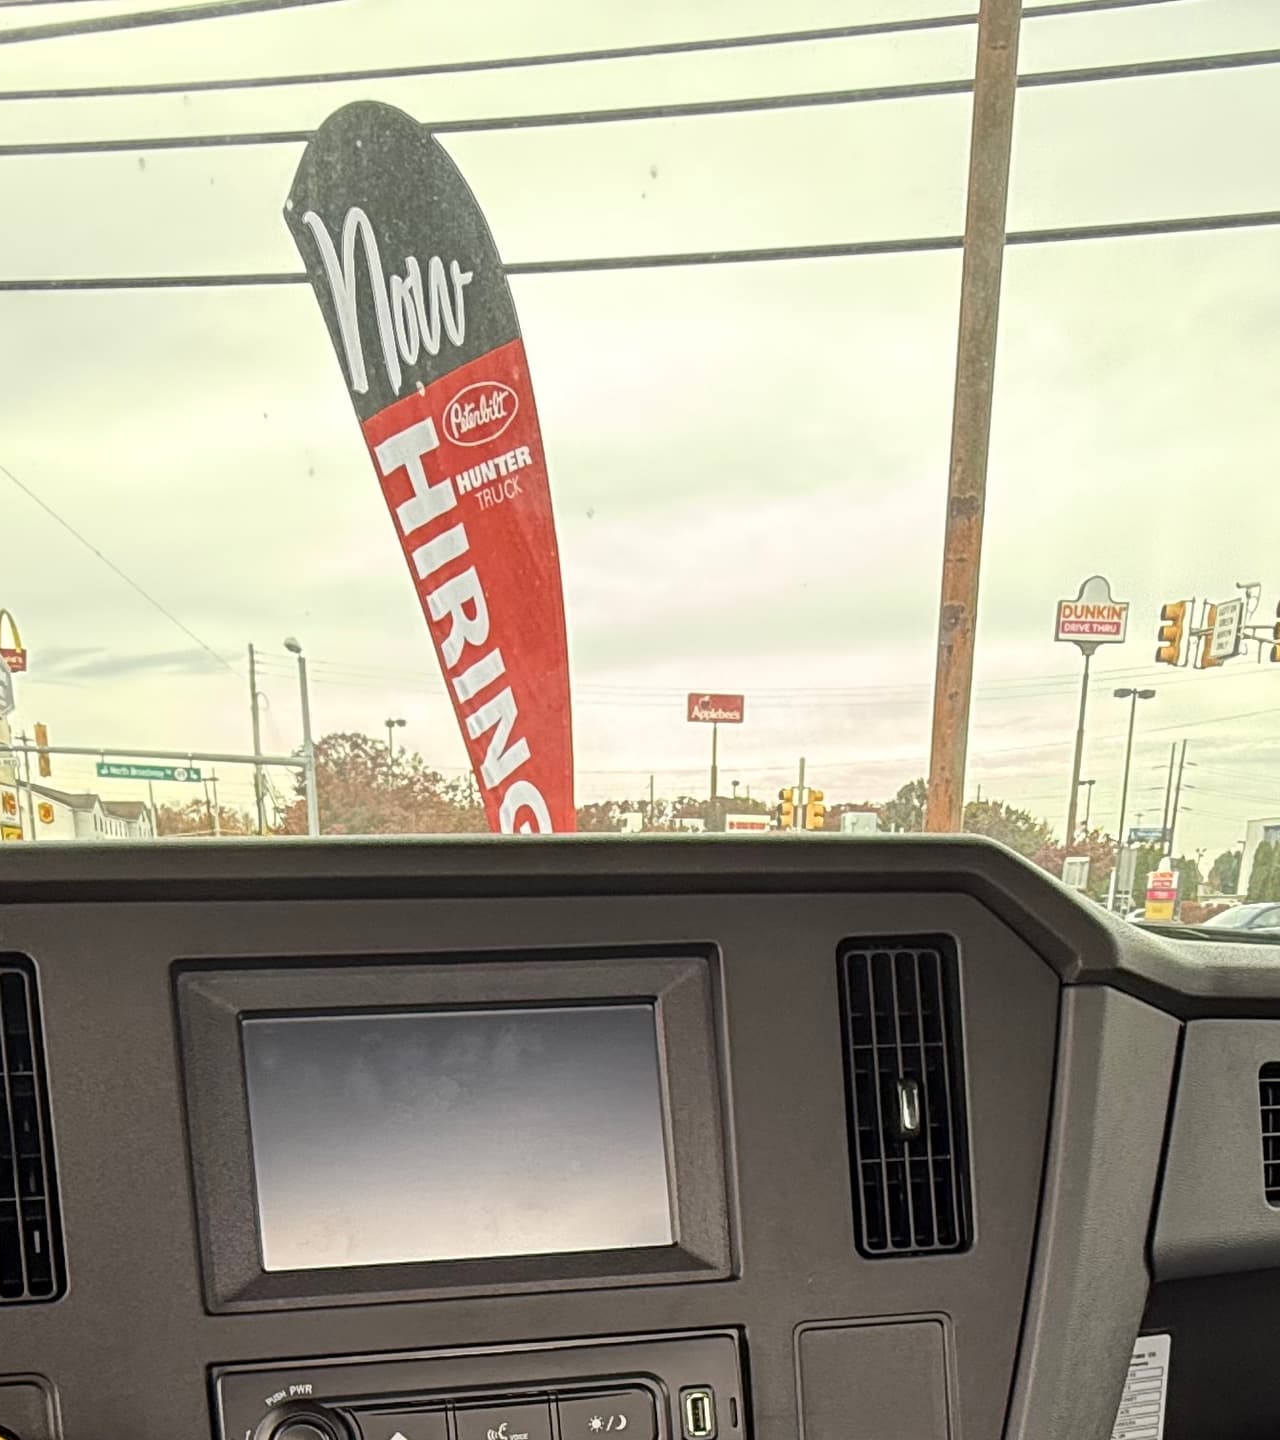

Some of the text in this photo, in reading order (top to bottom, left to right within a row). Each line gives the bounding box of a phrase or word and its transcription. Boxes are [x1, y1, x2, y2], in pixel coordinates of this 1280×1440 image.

[303, 205, 475, 398] Now
[450, 391, 508, 439] Peterbilt
[456, 446, 533, 495] HUNTER
[475, 475, 523, 511] TRUCK
[1062, 604, 1126, 620] DUNKIN'
[1064, 622, 1116, 633] DRIVE THRU
[691, 705, 740, 720] Applebee's
[264, 1384, 313, 1406] PUSH PWR
[510, 1432, 529, 1440] VOICE
